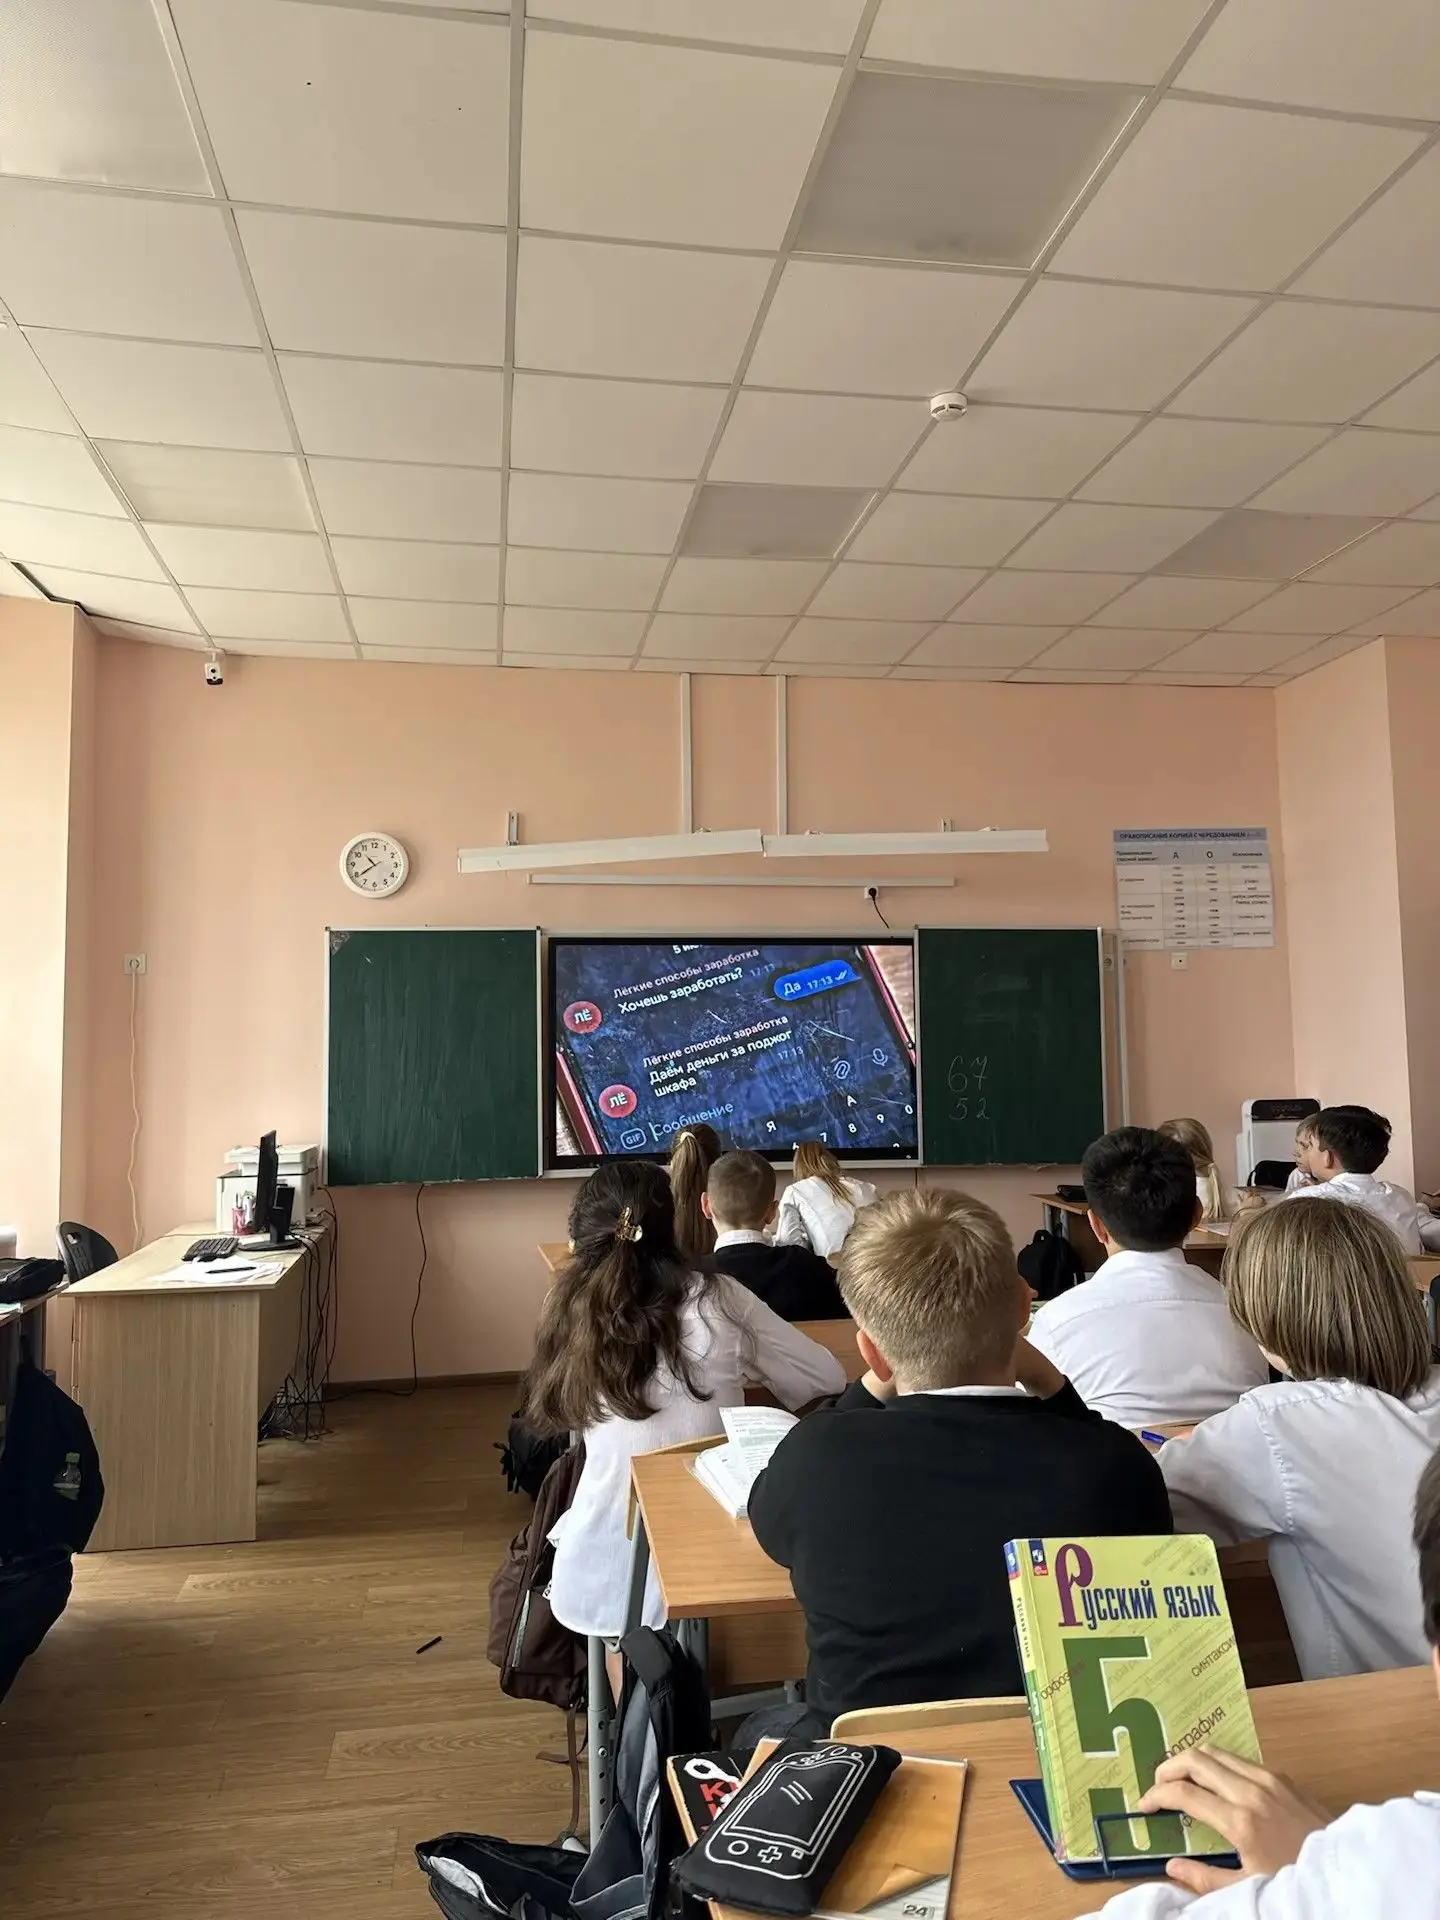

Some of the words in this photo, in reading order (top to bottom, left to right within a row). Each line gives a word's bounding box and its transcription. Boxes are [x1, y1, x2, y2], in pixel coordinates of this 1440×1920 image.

[613, 981, 653, 999] Лёгкие
[655, 966, 702, 987] способы
[704, 949, 759, 972] заработка
[618, 993, 669, 1014] Хочешь
[671, 967, 743, 1000] заработать?
[783, 982, 801, 996] Да
[807, 976, 833, 990] 17:13
[574, 1009, 593, 1024] ЛЁ
[643, 1049, 682, 1068] Лёгкие
[684, 1034, 732, 1055] способы
[734, 1015, 788, 1039] заработка
[649, 1065, 684, 1086] Даём
[687, 1051, 729, 1073] деньги
[731, 1046, 746, 1058] за
[748, 1030, 792, 1052] поджог
[654, 1077, 697, 1098] шкафа
[609, 1092, 628, 1108] ЛЁ
[847, 1095, 857, 1107] А
[877, 1113, 885, 1123] 9
[848, 1123, 857, 1133] 8
[626, 1133, 642, 1145] GIF
[1054, 1543, 1158, 1630] Русский
[1062, 1636, 1188, 1854] 5
[903, 1904, 928, 1917] 24
